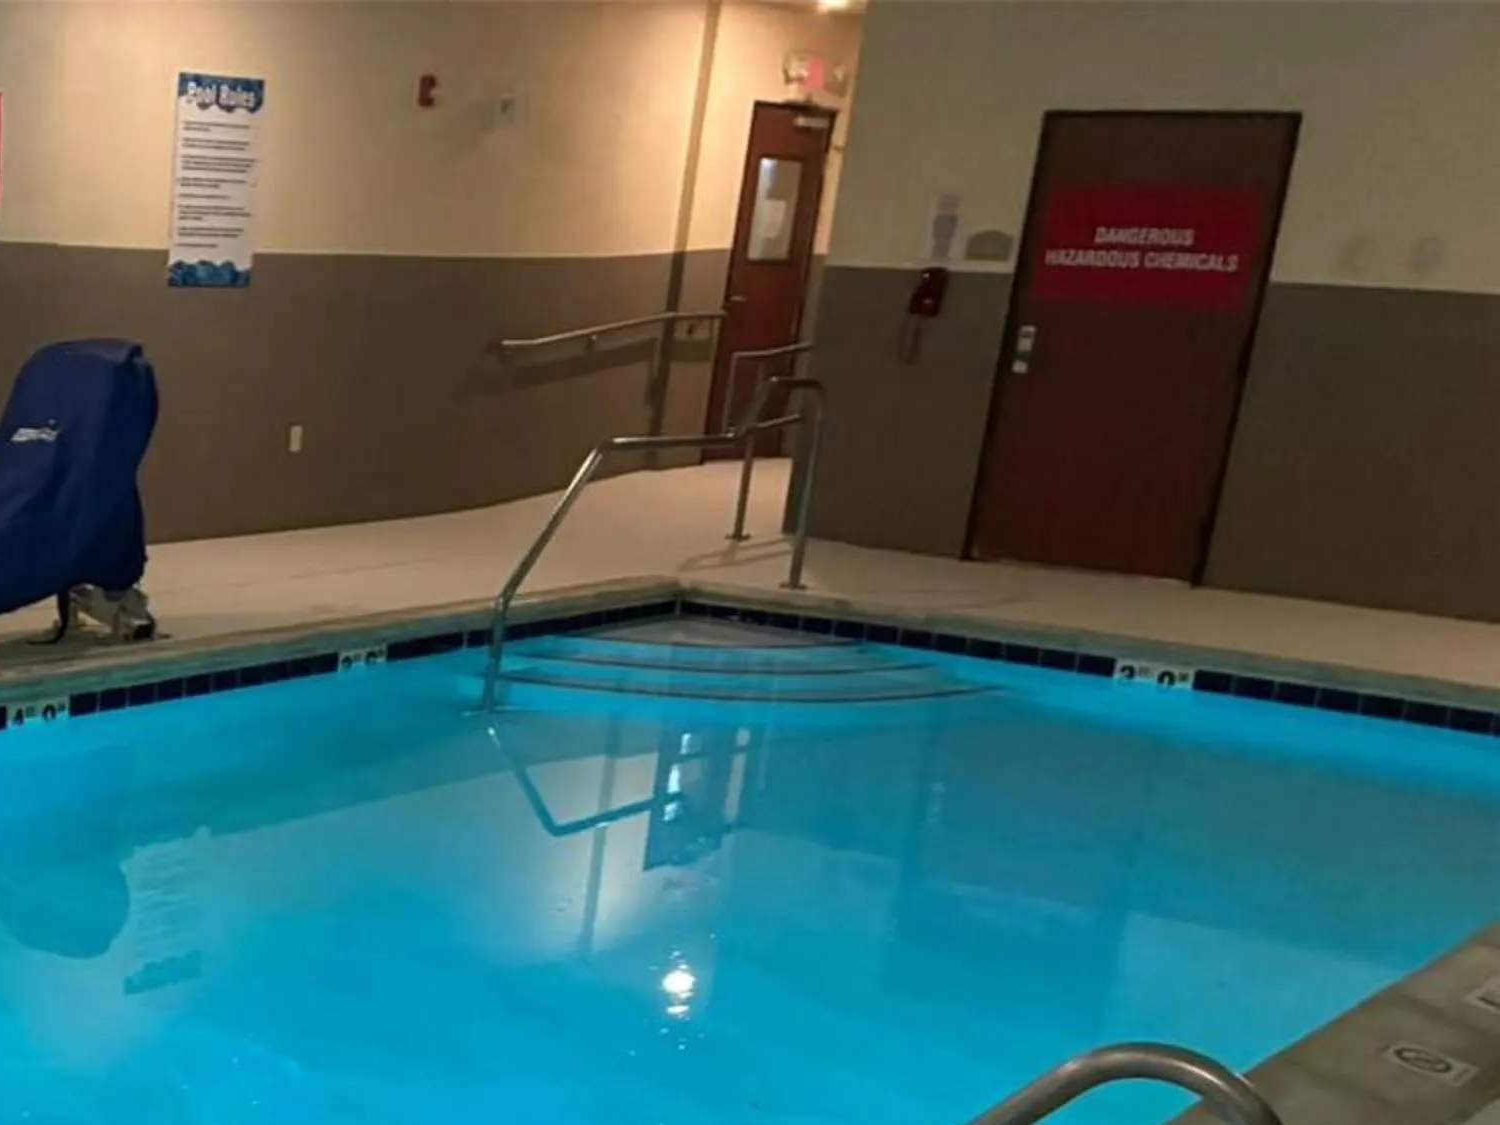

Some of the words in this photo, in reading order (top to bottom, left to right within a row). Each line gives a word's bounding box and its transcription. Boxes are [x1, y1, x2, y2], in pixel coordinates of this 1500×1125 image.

[1094, 226, 1196, 246] DANGEROUS
[1045, 248, 1140, 268] HAZARDOUS
[1143, 252, 1239, 273] CHEMICALS
